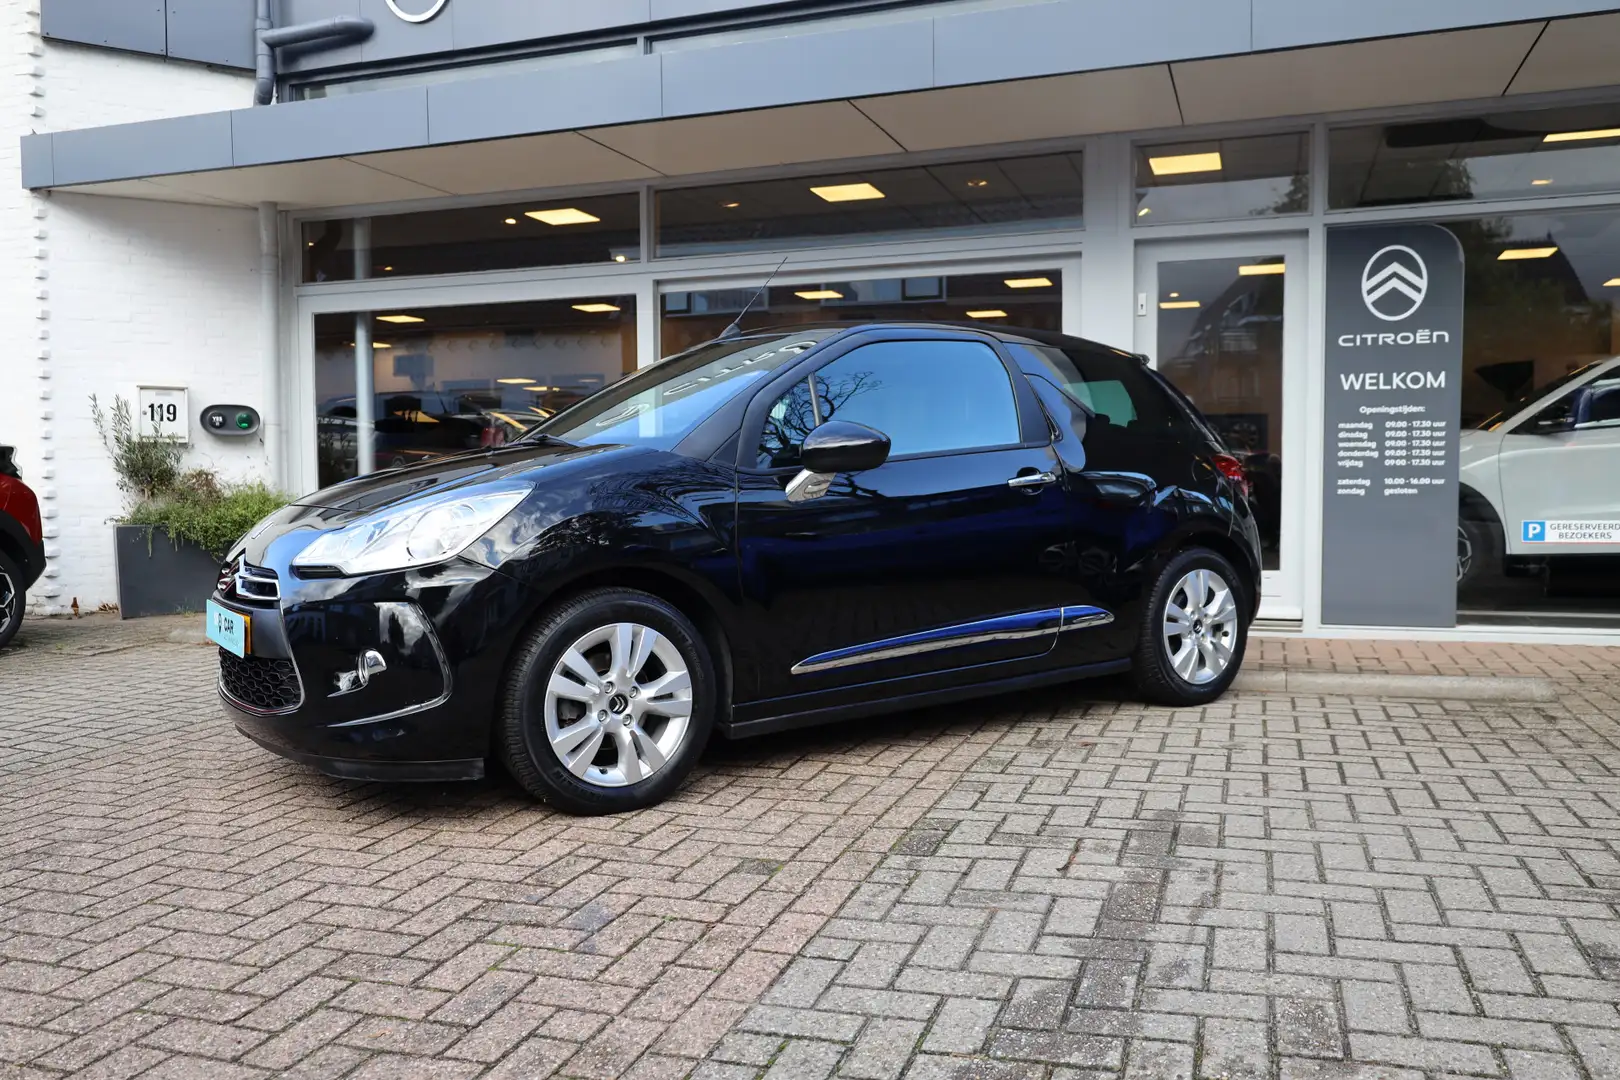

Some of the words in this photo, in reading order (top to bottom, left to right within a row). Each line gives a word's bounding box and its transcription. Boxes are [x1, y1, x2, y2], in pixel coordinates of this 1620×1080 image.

[1340, 371, 1446, 391] WELKOM
[148, 403, 177, 422] 119
[1359, 405, 1426, 415] Openingstijden:
[1412, 420, 1432, 428] 17.30
[1412, 439, 1432, 447] 17.30
[1412, 449, 1431, 457] 17.30
[1528, 524, 1541, 538] P
[1549, 523, 1620, 531] GERESERVEERD
[1558, 532, 1612, 540] BEZOEKERS
